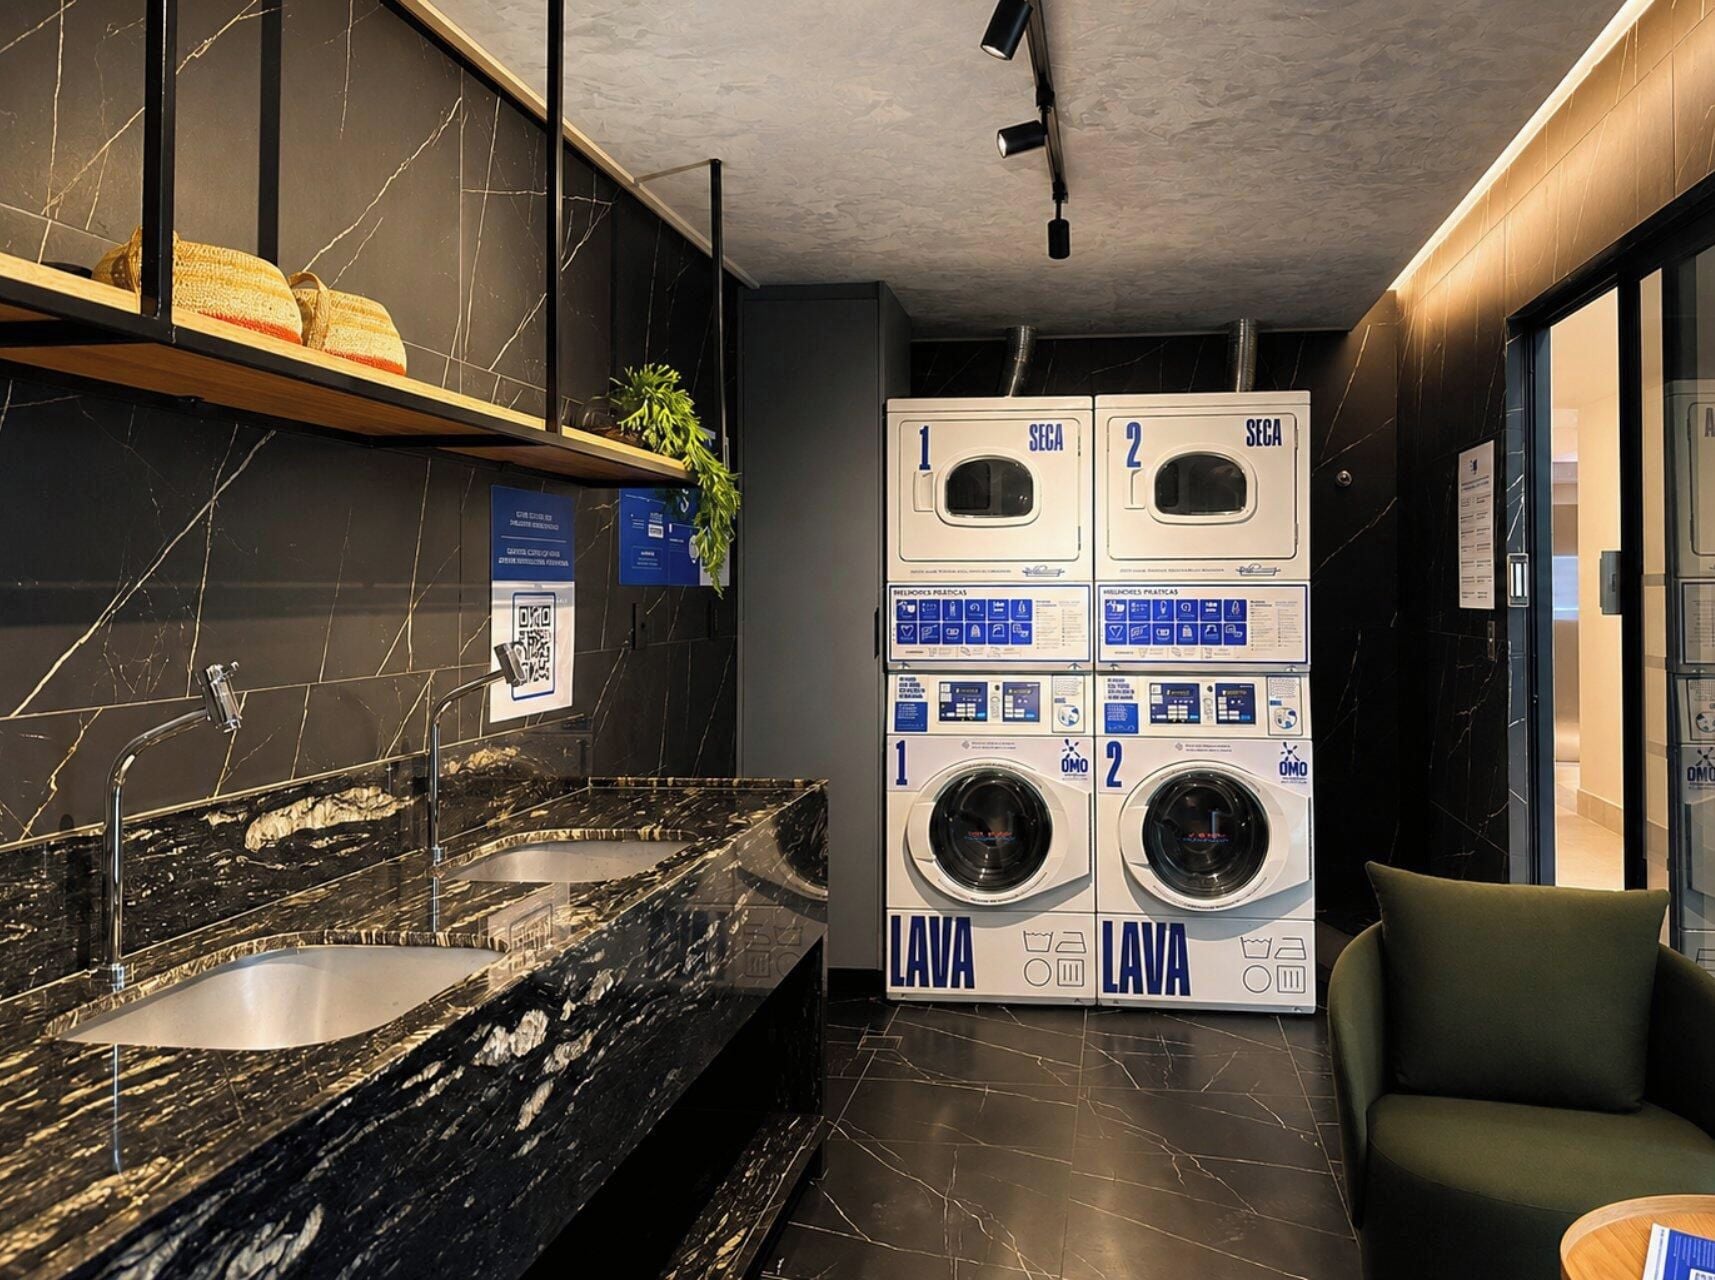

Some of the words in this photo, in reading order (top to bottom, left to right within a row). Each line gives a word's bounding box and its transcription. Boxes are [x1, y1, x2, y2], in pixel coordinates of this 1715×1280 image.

[919, 425, 931, 470] 1
[1029, 423, 1063, 451] SECA
[1126, 421, 1142, 468] 2
[1246, 418, 1282, 447] SECA
[896, 740, 908, 786] 1
[1061, 758, 1088, 773] OMO
[1106, 741, 1122, 787] 2
[1279, 761, 1308, 776] OMO
[891, 915, 975, 989] LAVA
[1103, 920, 1191, 996] LAVA
